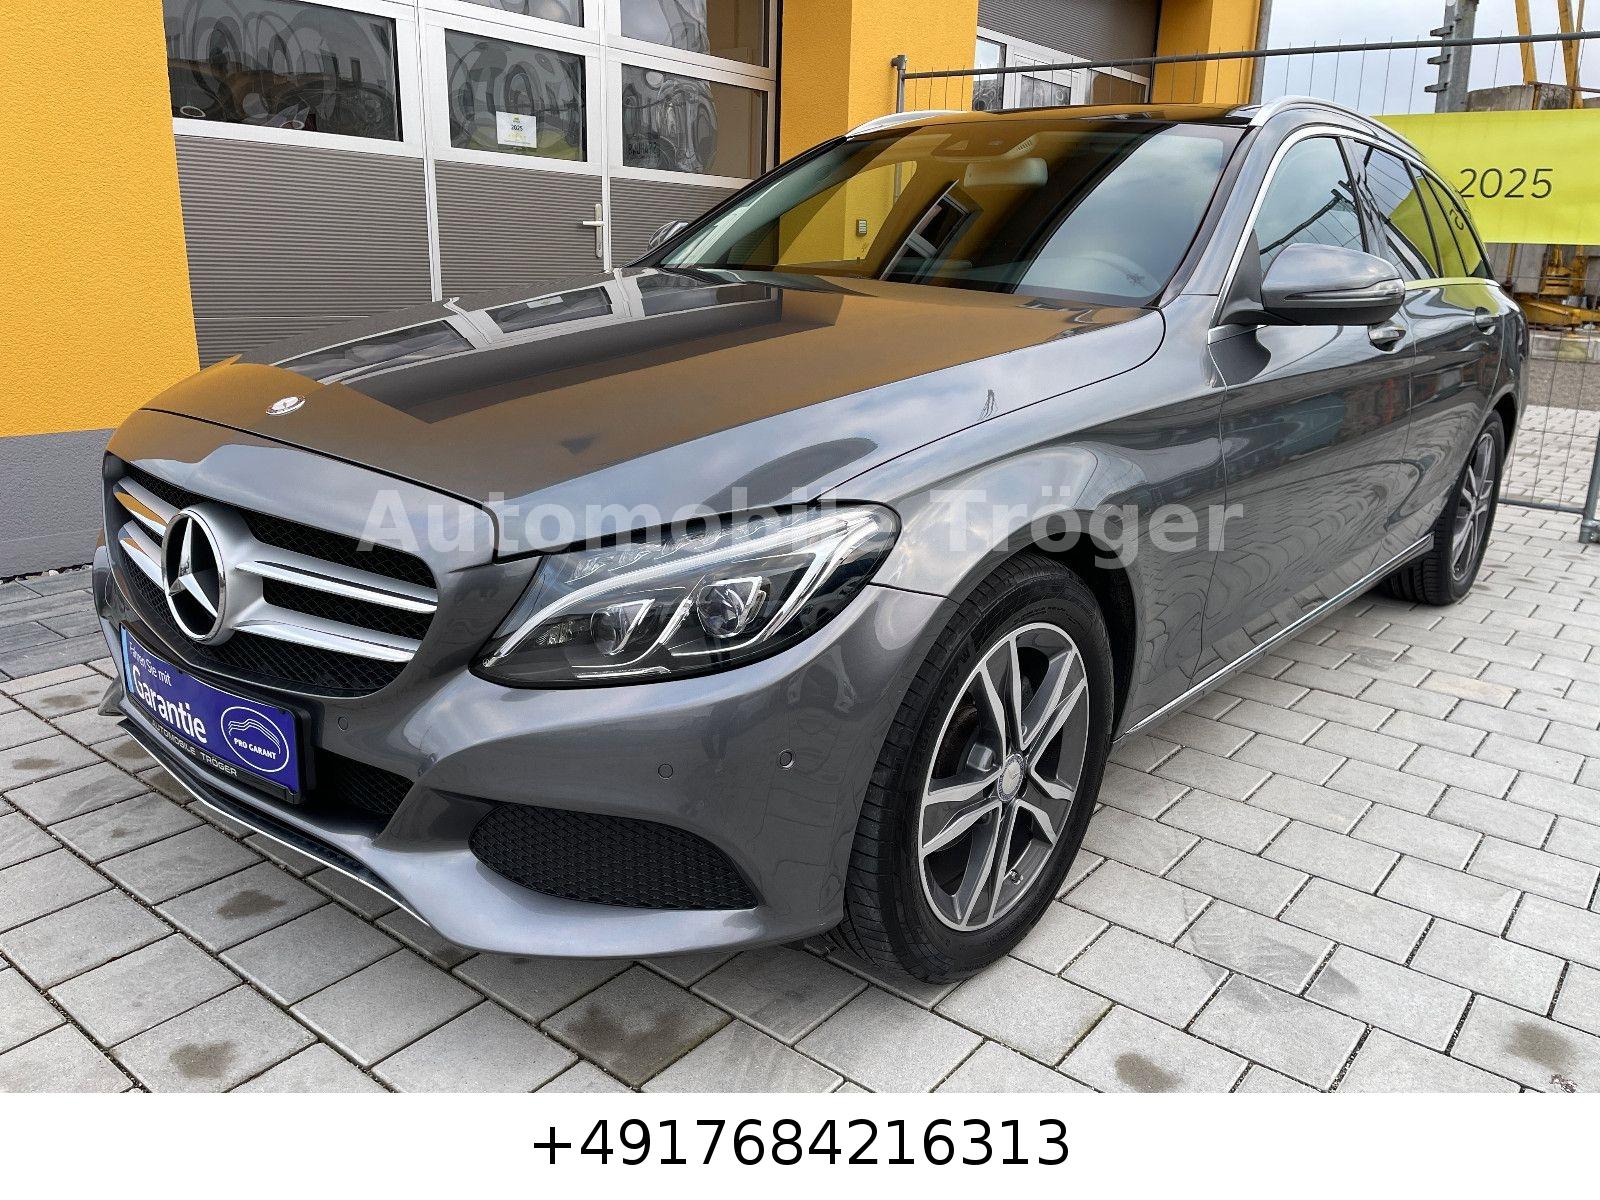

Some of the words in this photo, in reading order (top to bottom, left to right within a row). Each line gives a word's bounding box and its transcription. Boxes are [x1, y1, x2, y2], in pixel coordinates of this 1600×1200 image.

[1458, 167, 1554, 199] 2025
[132, 664, 208, 744] Garantie
[151, 719, 197, 756] AUTOMOBILE
[200, 751, 238, 777] TRÖGER
[233, 737, 248, 749] PRO
[248, 743, 277, 760] GARANT
